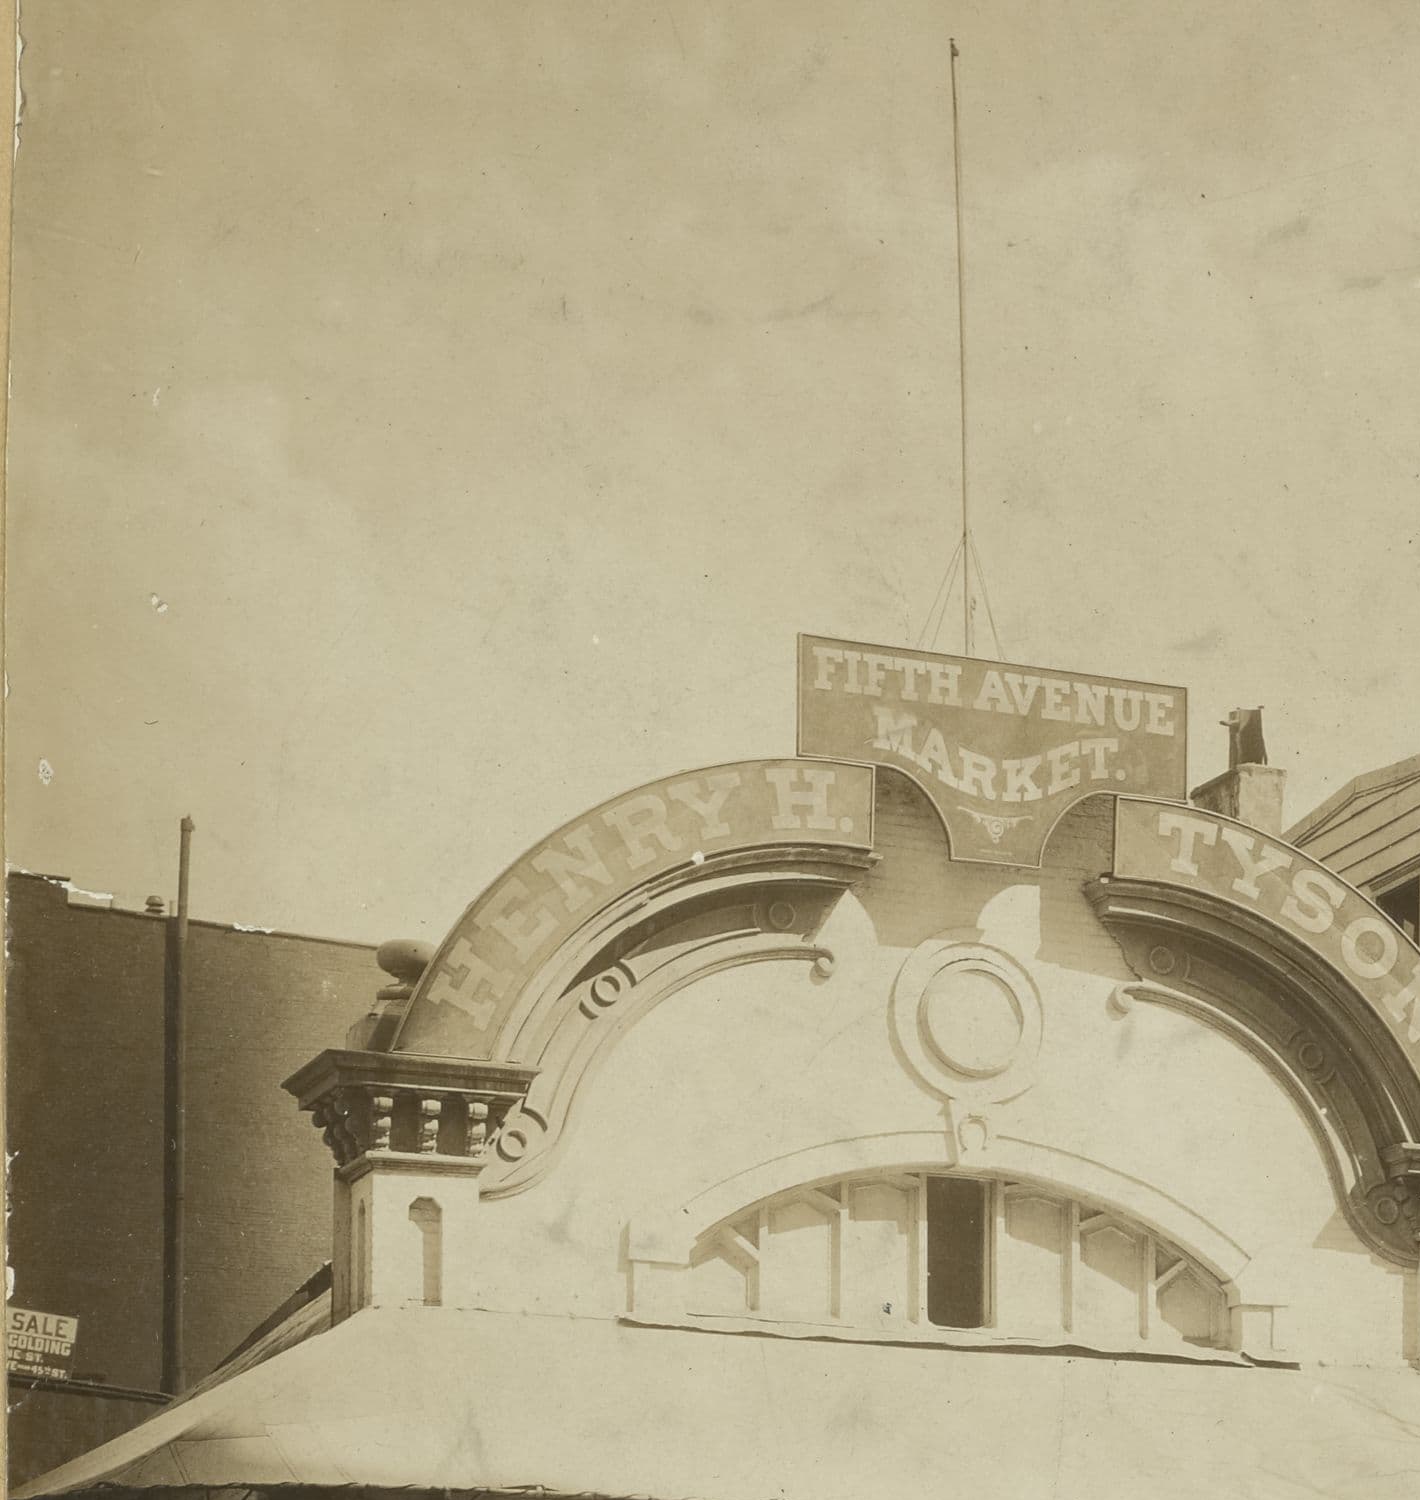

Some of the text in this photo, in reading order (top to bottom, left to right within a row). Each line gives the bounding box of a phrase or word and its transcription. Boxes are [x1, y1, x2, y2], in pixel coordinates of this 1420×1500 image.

[812, 646, 1174, 737] FIFTH AVENUE
[870, 705, 1126, 802] MARKET.
[426, 767, 855, 1033] HENRY H.
[8, 1334, 71, 1357] GOLDING
[11, 1312, 68, 1339] SALE
